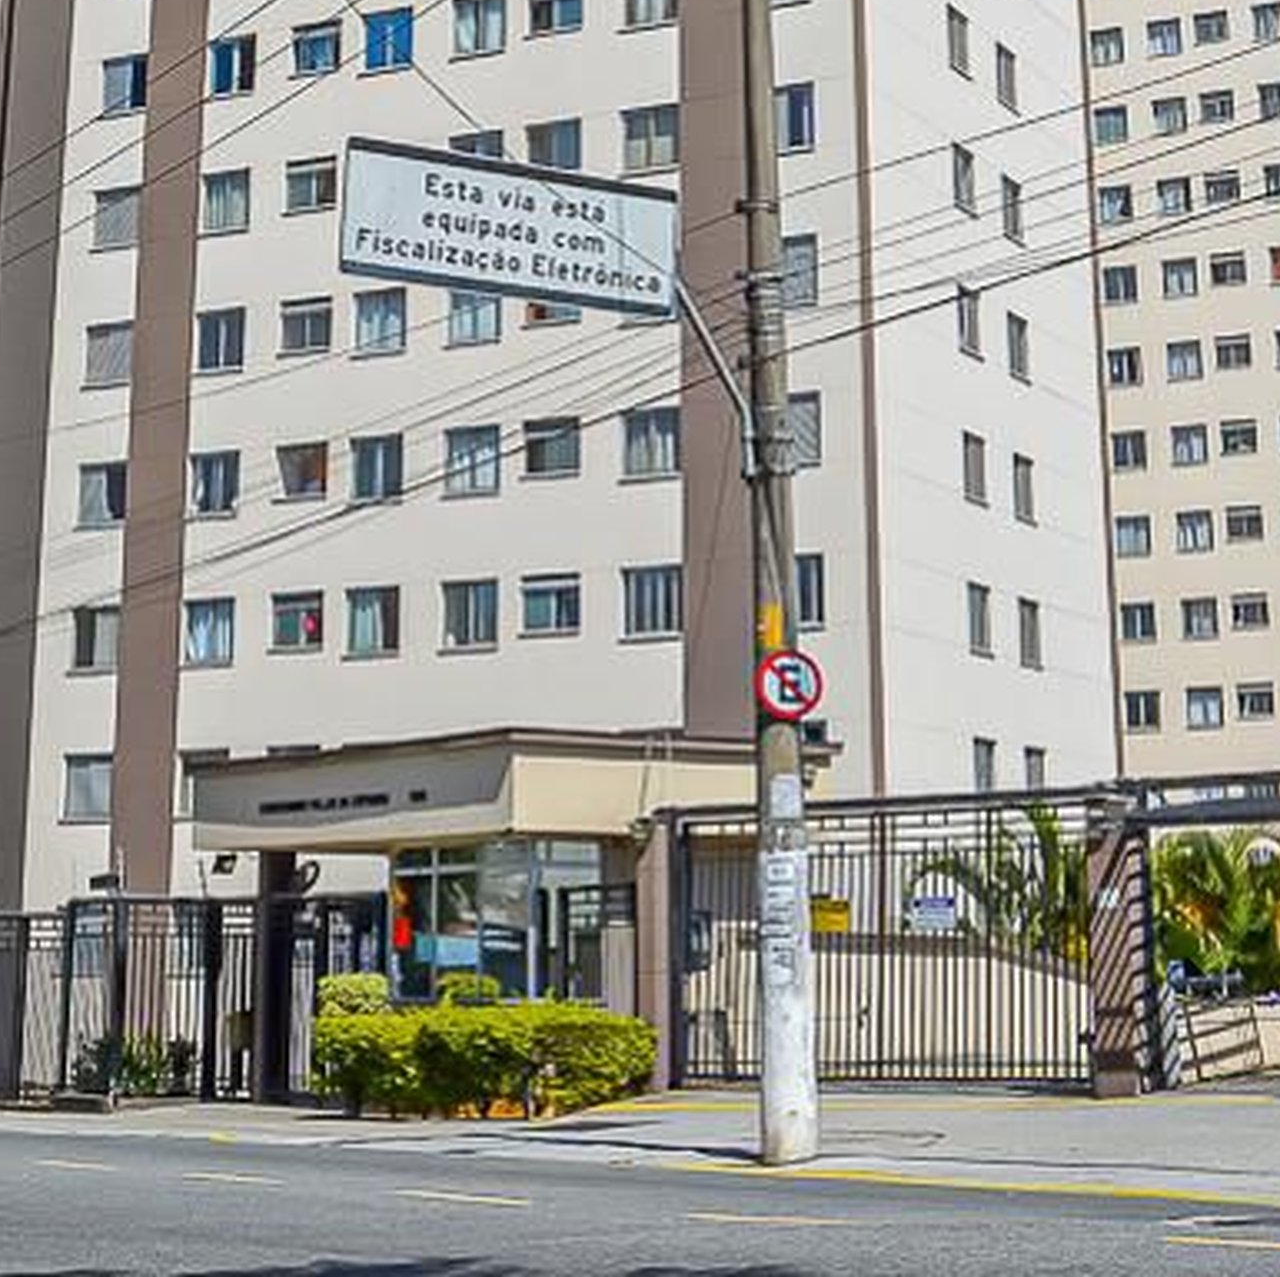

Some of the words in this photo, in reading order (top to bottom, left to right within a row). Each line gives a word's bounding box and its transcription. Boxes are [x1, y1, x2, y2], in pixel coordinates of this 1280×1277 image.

[424, 172, 484, 205] Esta
[498, 186, 535, 213] via
[422, 209, 539, 245] equipada
[552, 231, 605, 254] com
[355, 227, 521, 273] Fiscalização
[531, 253, 662, 294] Eletrônica
